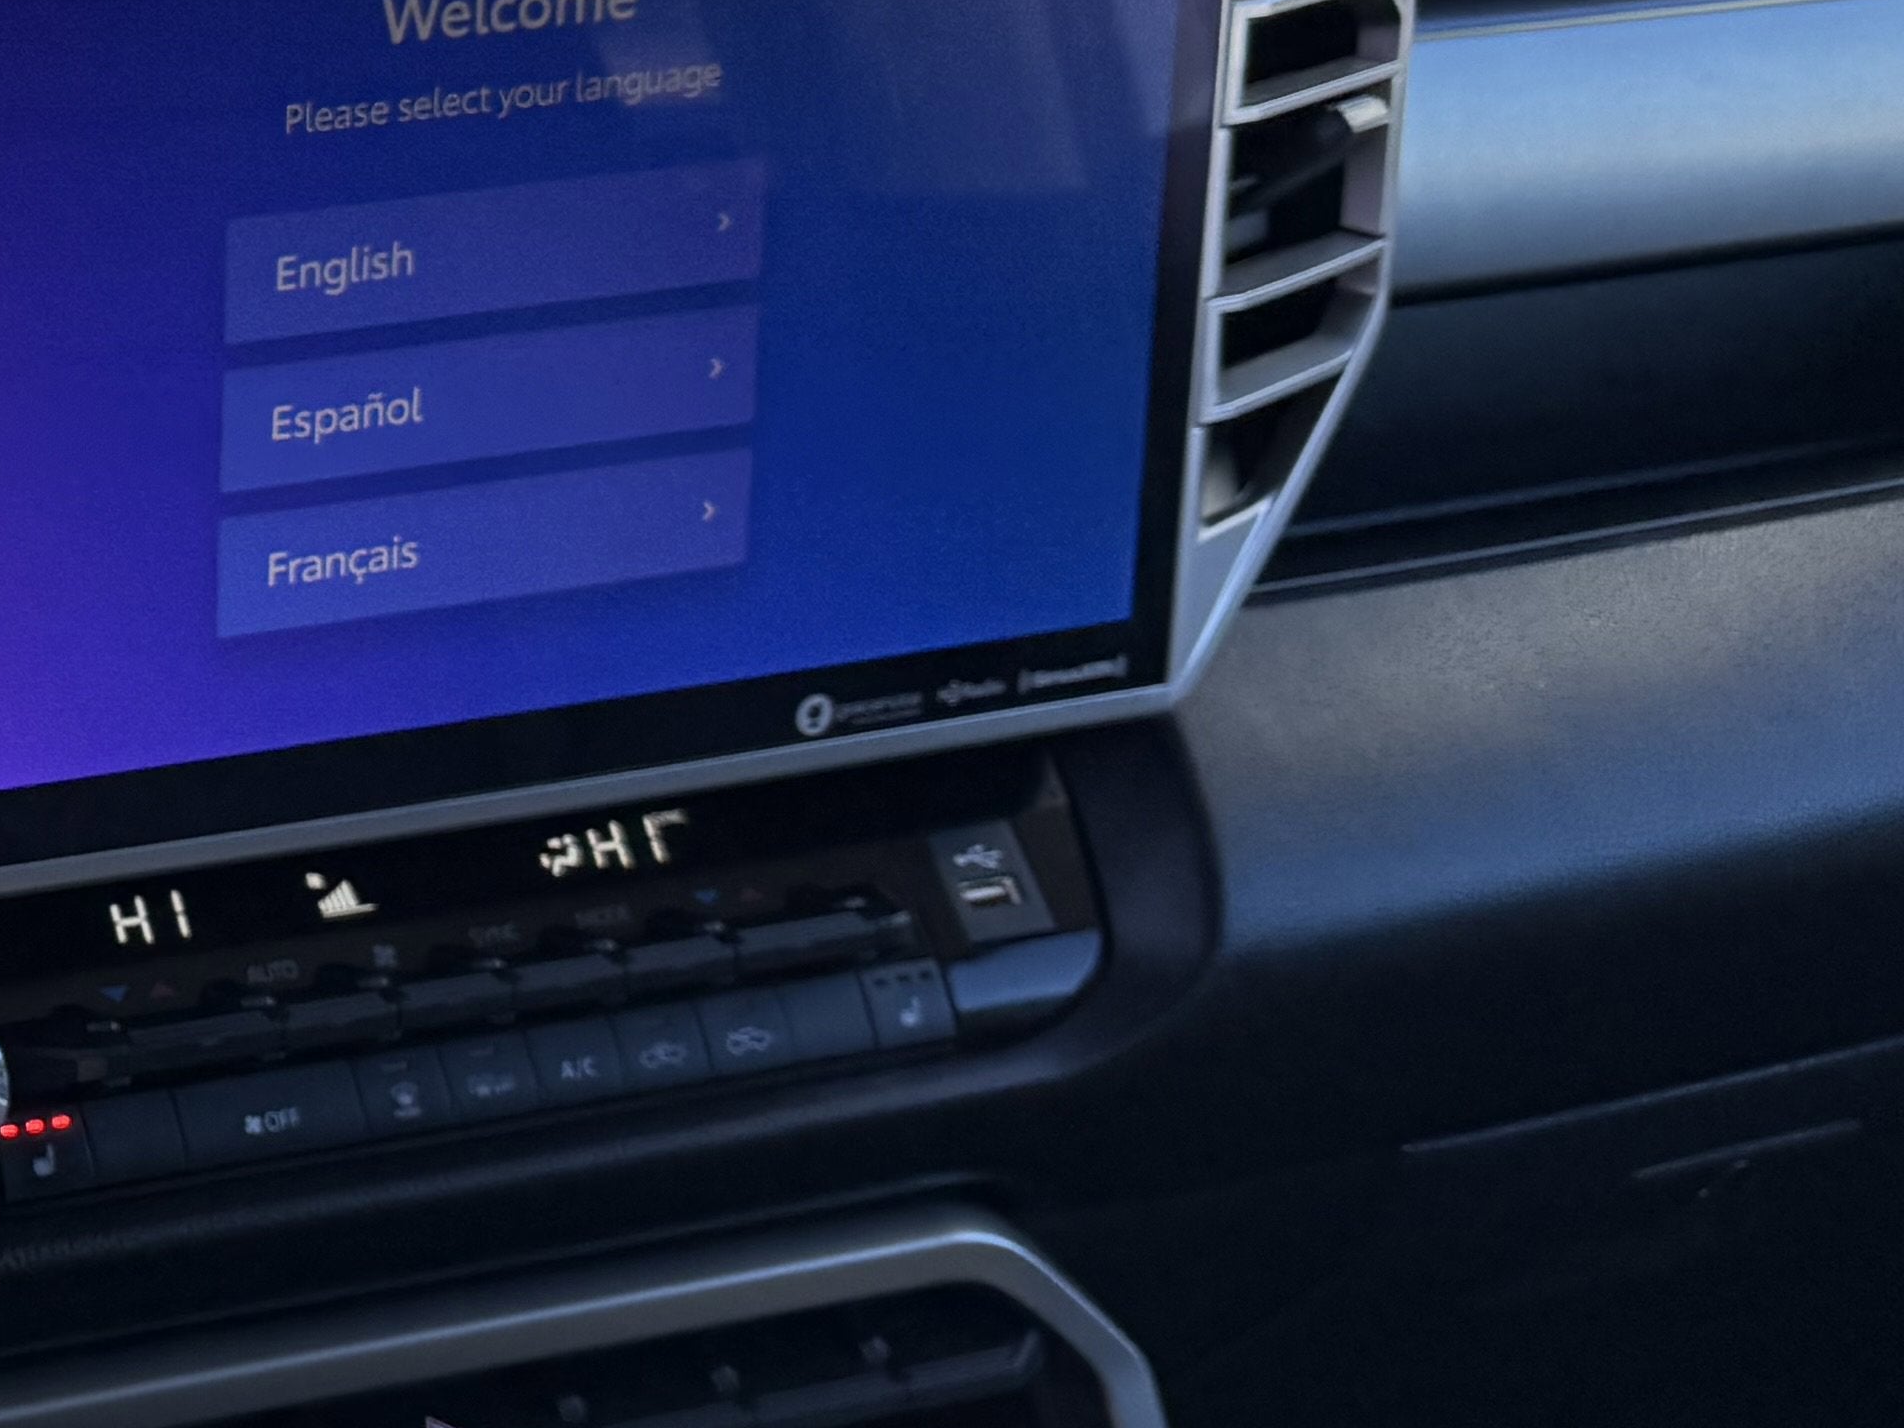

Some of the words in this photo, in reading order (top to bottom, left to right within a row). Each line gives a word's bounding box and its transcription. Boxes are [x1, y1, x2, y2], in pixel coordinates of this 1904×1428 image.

[285, 95, 390, 135] Please
[397, 86, 491, 125] select
[498, 79, 568, 119] your
[575, 60, 724, 110] language
[275, 242, 416, 296] English
[270, 387, 424, 444] Español
[266, 535, 420, 587] Français
[559, 1055, 599, 1081] A/C
[264, 1105, 300, 1133] OFF
